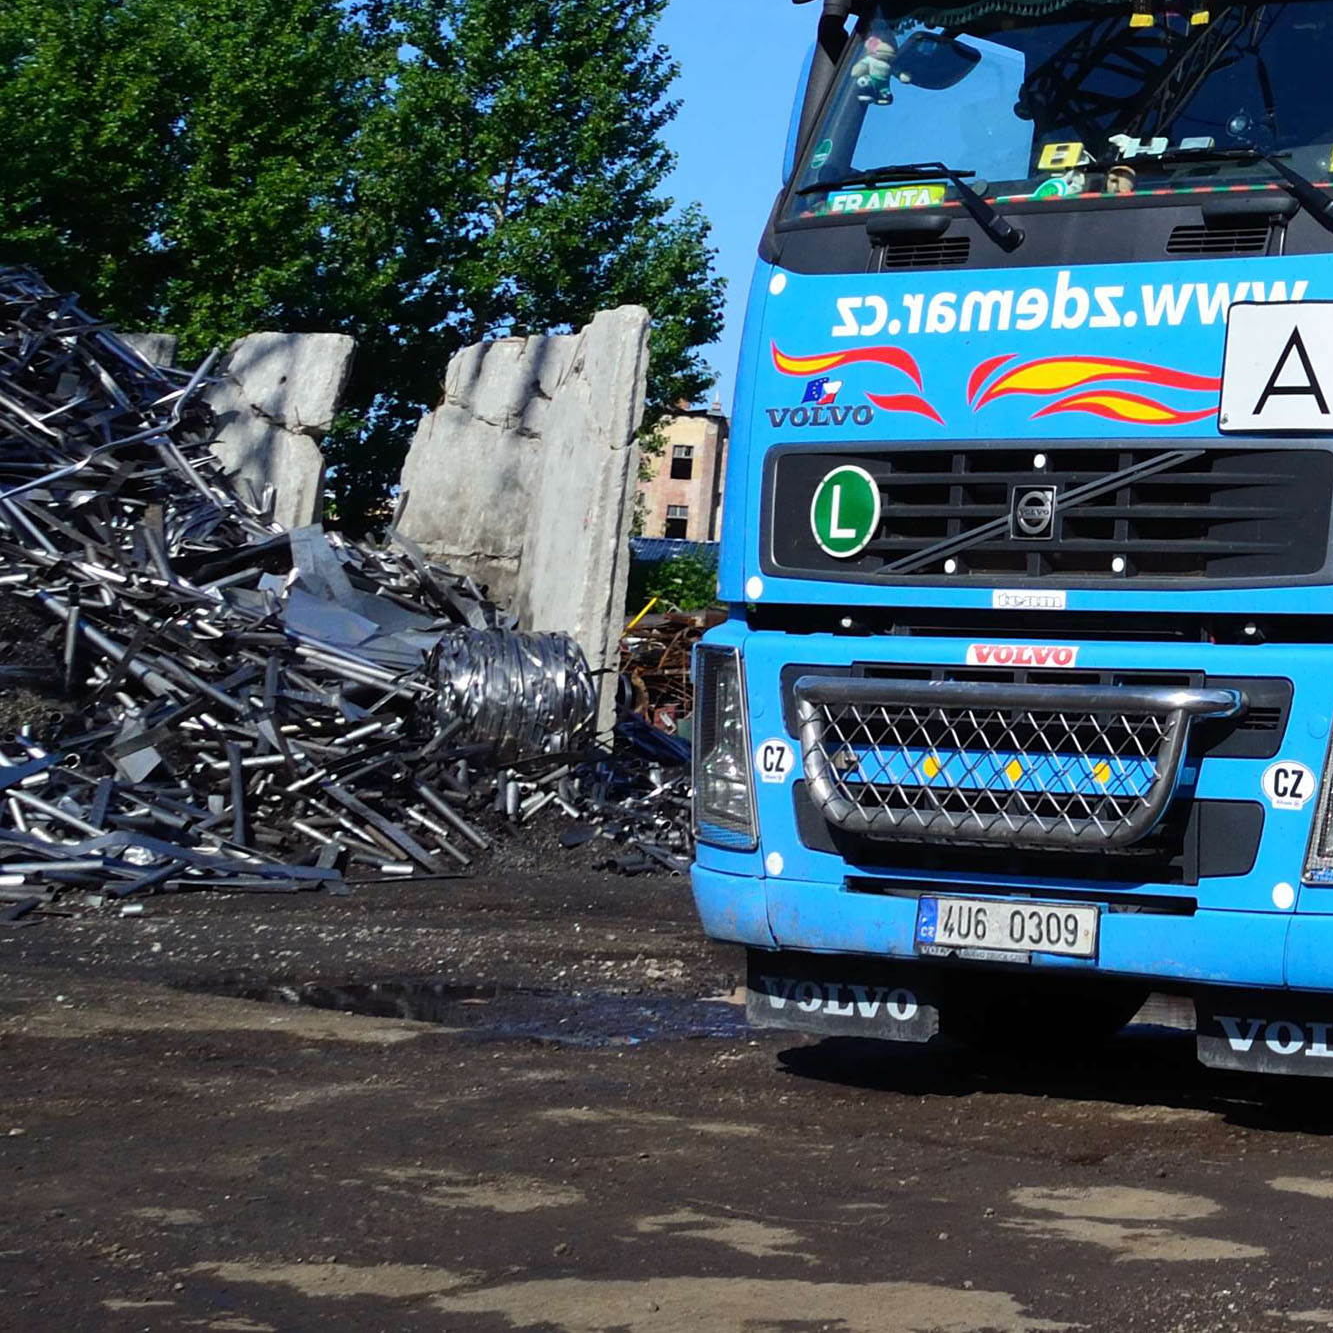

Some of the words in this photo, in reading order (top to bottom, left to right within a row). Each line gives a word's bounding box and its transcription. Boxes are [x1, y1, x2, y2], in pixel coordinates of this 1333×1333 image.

[830, 189, 932, 212] FRANTA
[1252, 324, 1331, 416] A
[765, 404, 875, 429] VOLVO
[829, 484, 856, 539] L
[972, 644, 1074, 666] VOLVO
[763, 745, 786, 773] CZ
[1273, 768, 1304, 799] CZ
[920, 926, 935, 938] CZ
[943, 905, 988, 941] 4U6
[1009, 909, 1079, 948] 0309
[920, 946, 953, 958] VOLV
[760, 974, 918, 1021] VOLVO
